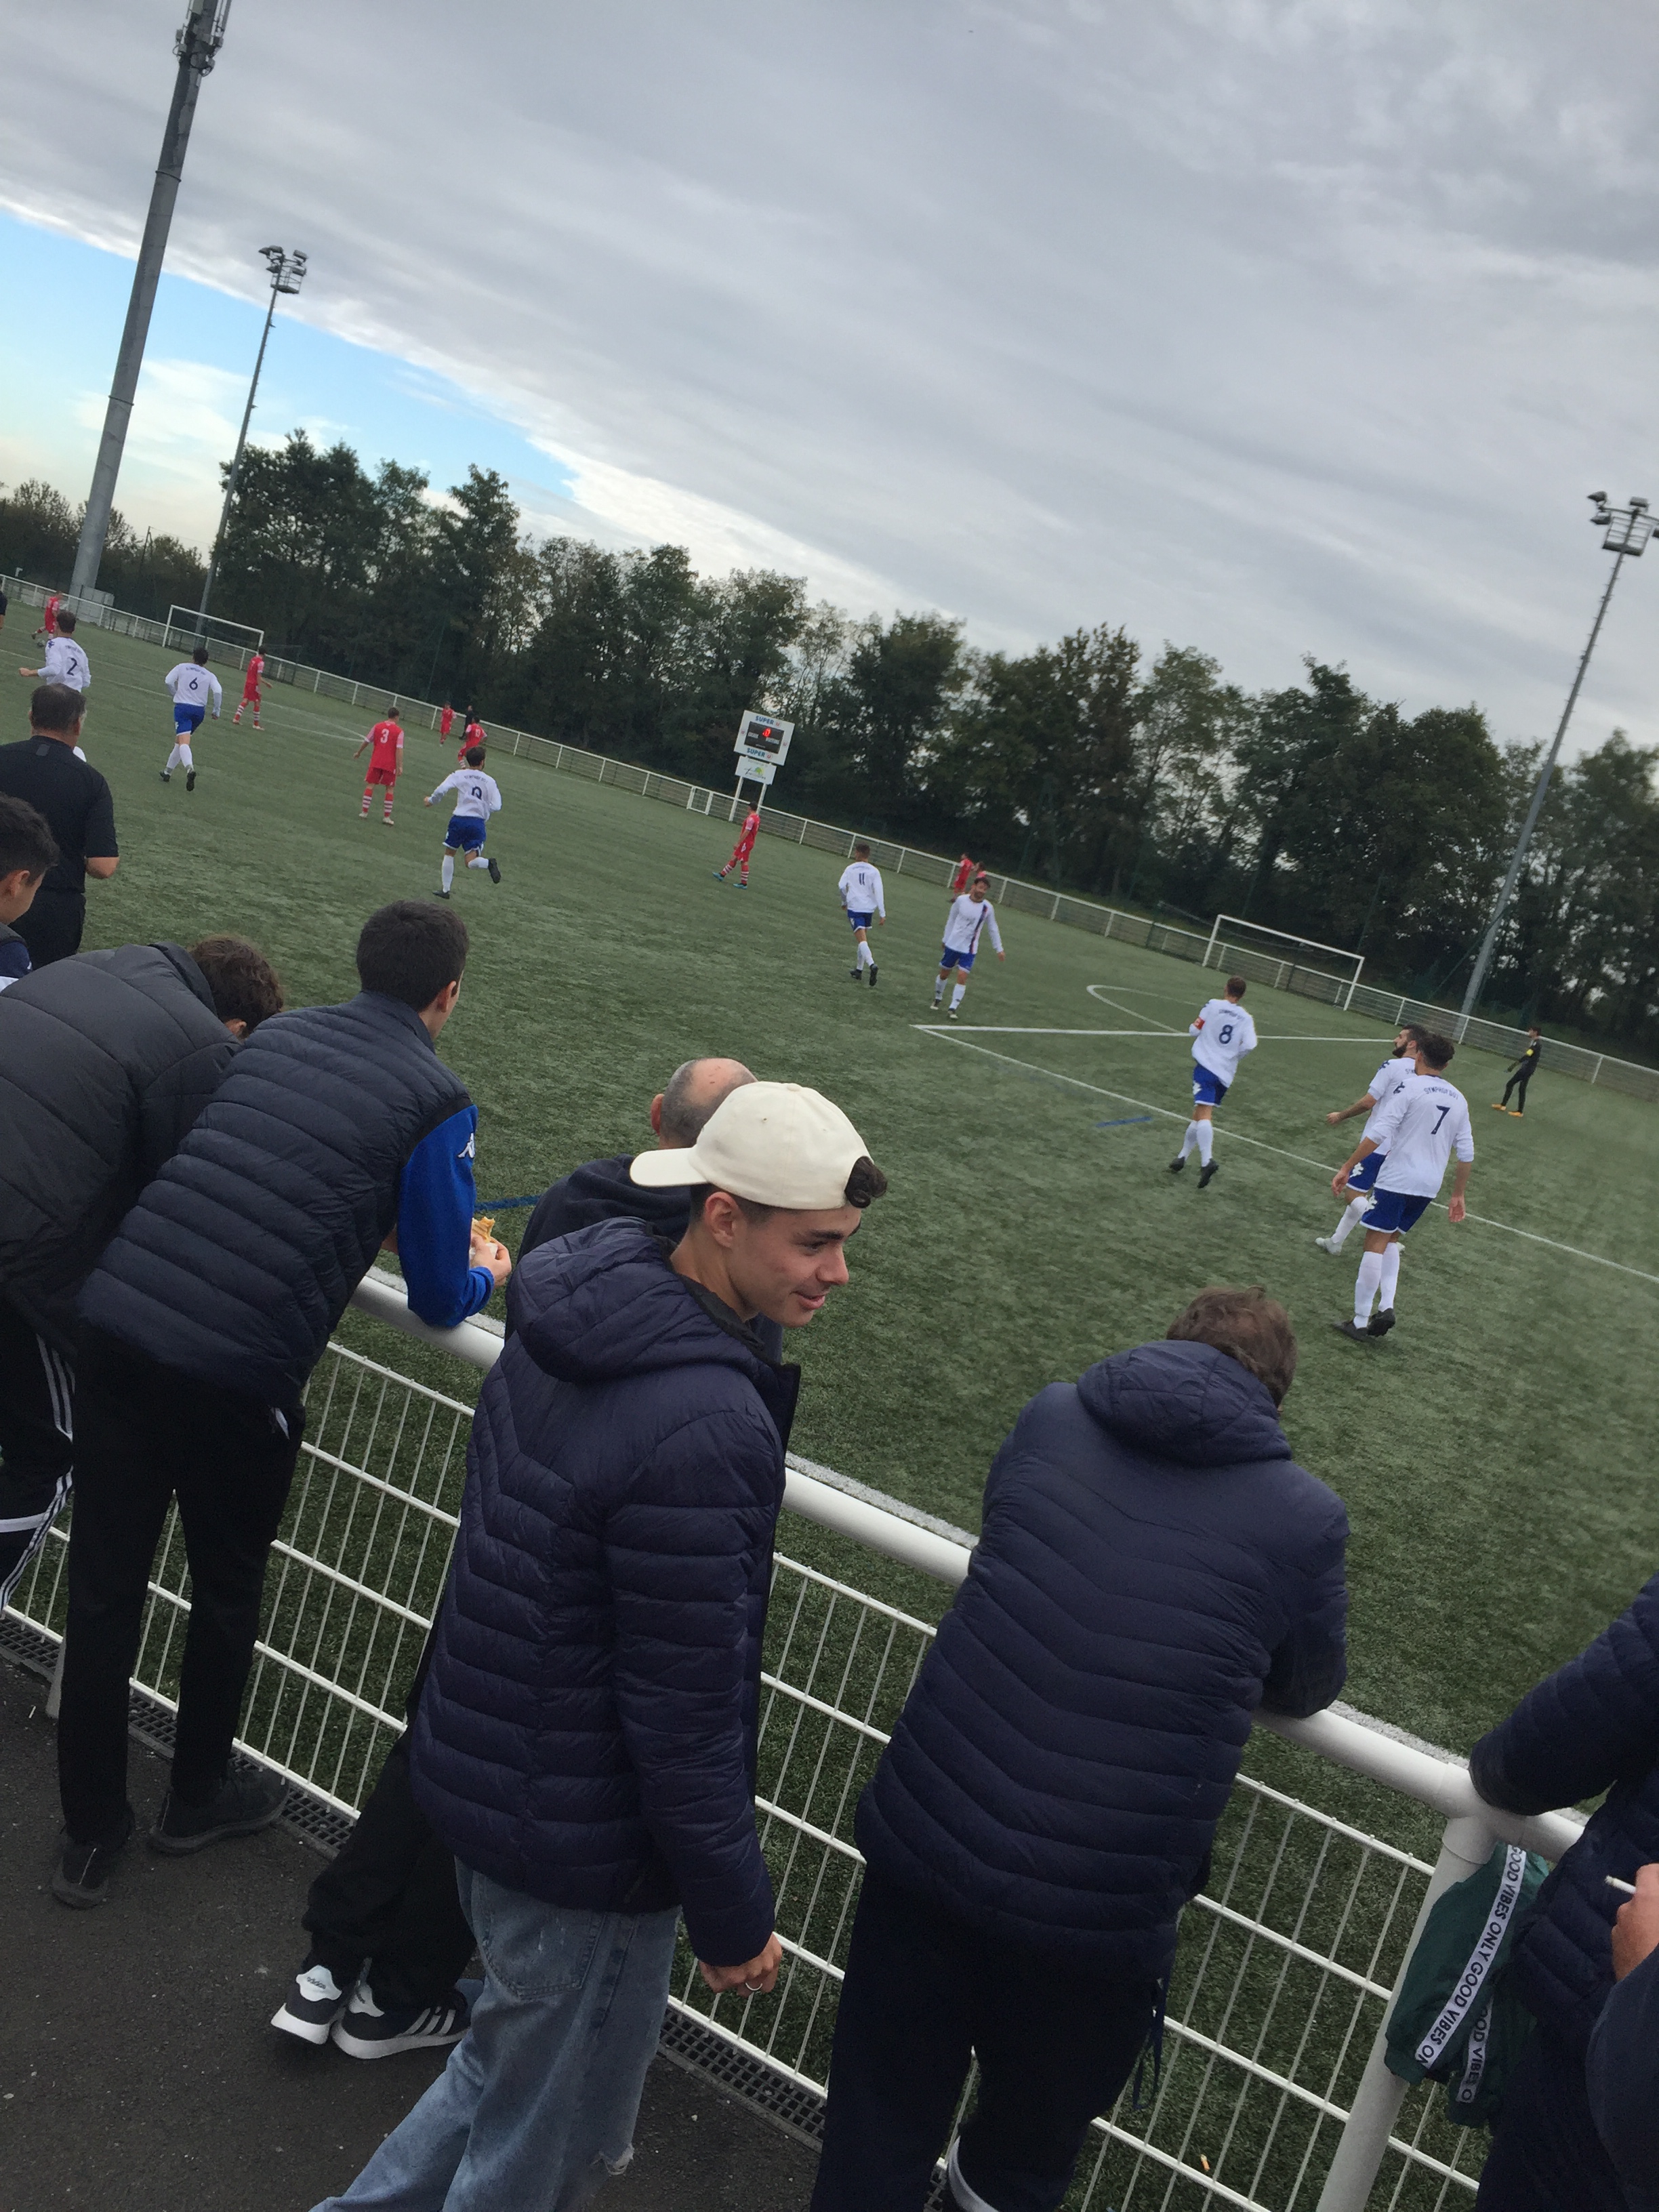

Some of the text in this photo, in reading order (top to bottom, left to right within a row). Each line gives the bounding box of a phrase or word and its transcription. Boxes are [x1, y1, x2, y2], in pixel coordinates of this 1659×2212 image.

[66, 657, 78, 676] 2
[188, 677, 199, 691] 6
[756, 716, 774, 724] SUPER
[380, 728, 390, 743] 3
[747, 748, 765, 757] SUPER
[1218, 1024, 1233, 1044] 8
[1431, 1105, 1450, 1135] 7
[1494, 1883, 1516, 1920] VIBES
[1477, 1921, 1502, 1963] ONLY
[1454, 1961, 1483, 2008] GOOD
[1430, 2009, 1460, 2045] VIBES
